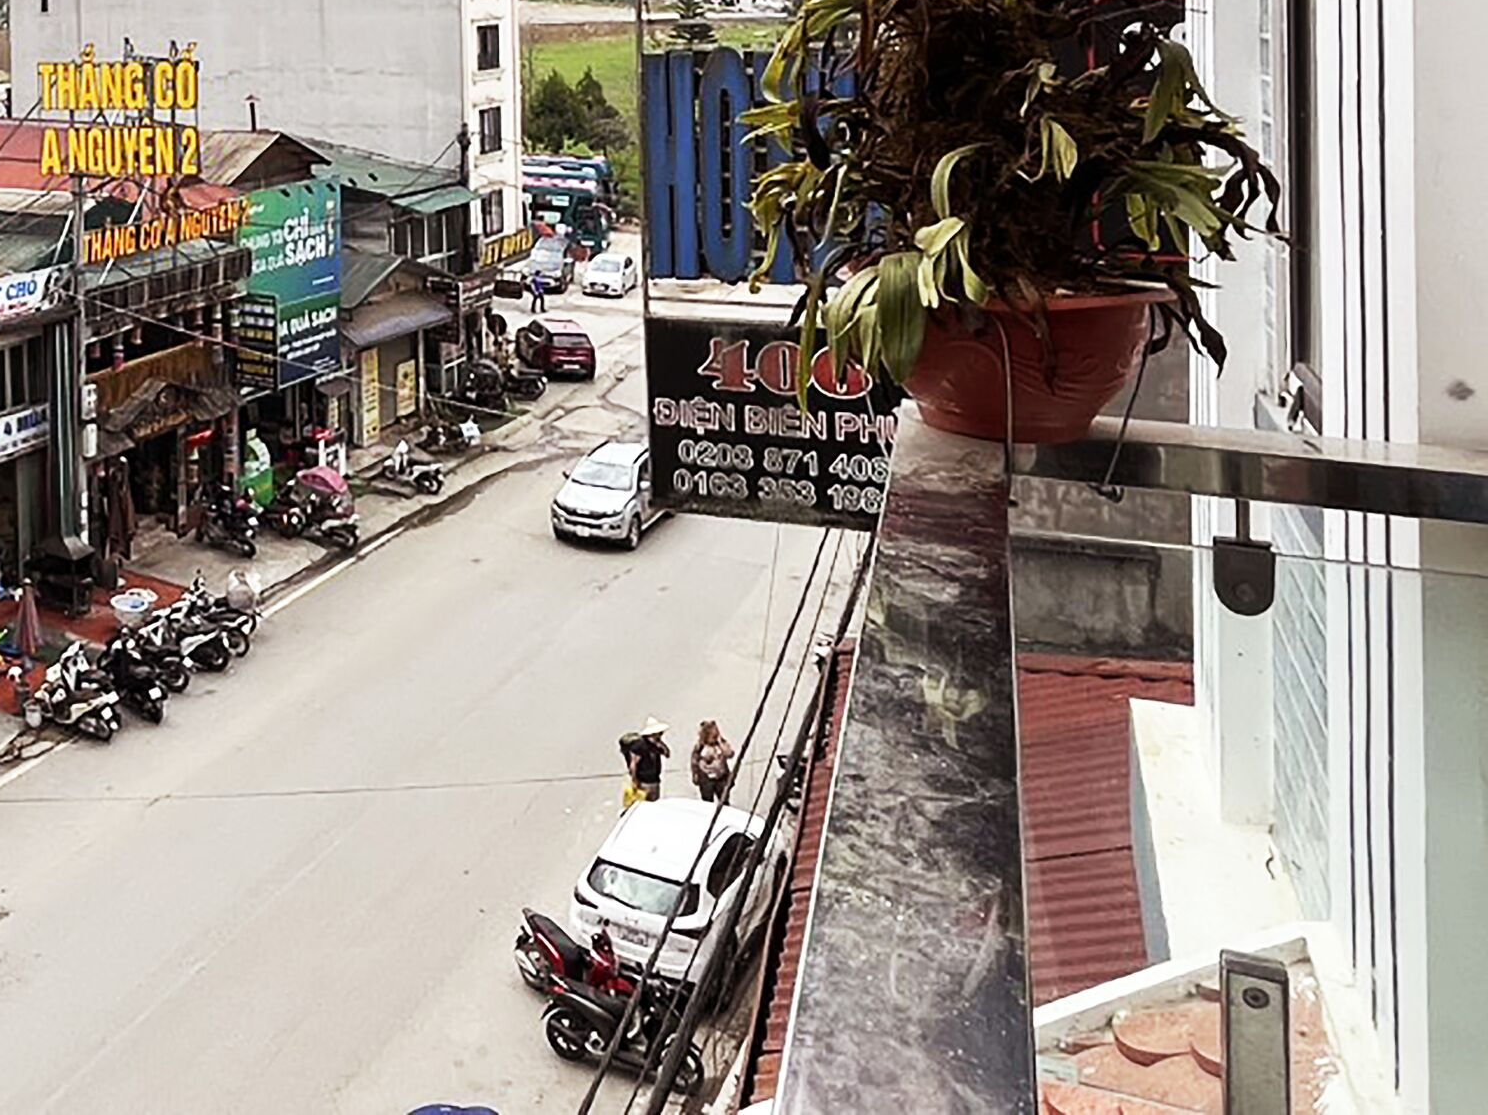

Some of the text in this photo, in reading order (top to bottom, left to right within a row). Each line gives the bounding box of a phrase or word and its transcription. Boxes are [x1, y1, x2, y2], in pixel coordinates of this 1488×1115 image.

[41, 117, 198, 178] A NGUYÊN 2
[652, 396, 736, 435] ĐIỆN
[744, 403, 828, 441] BIÊN
[762, 446, 820, 477] 871
